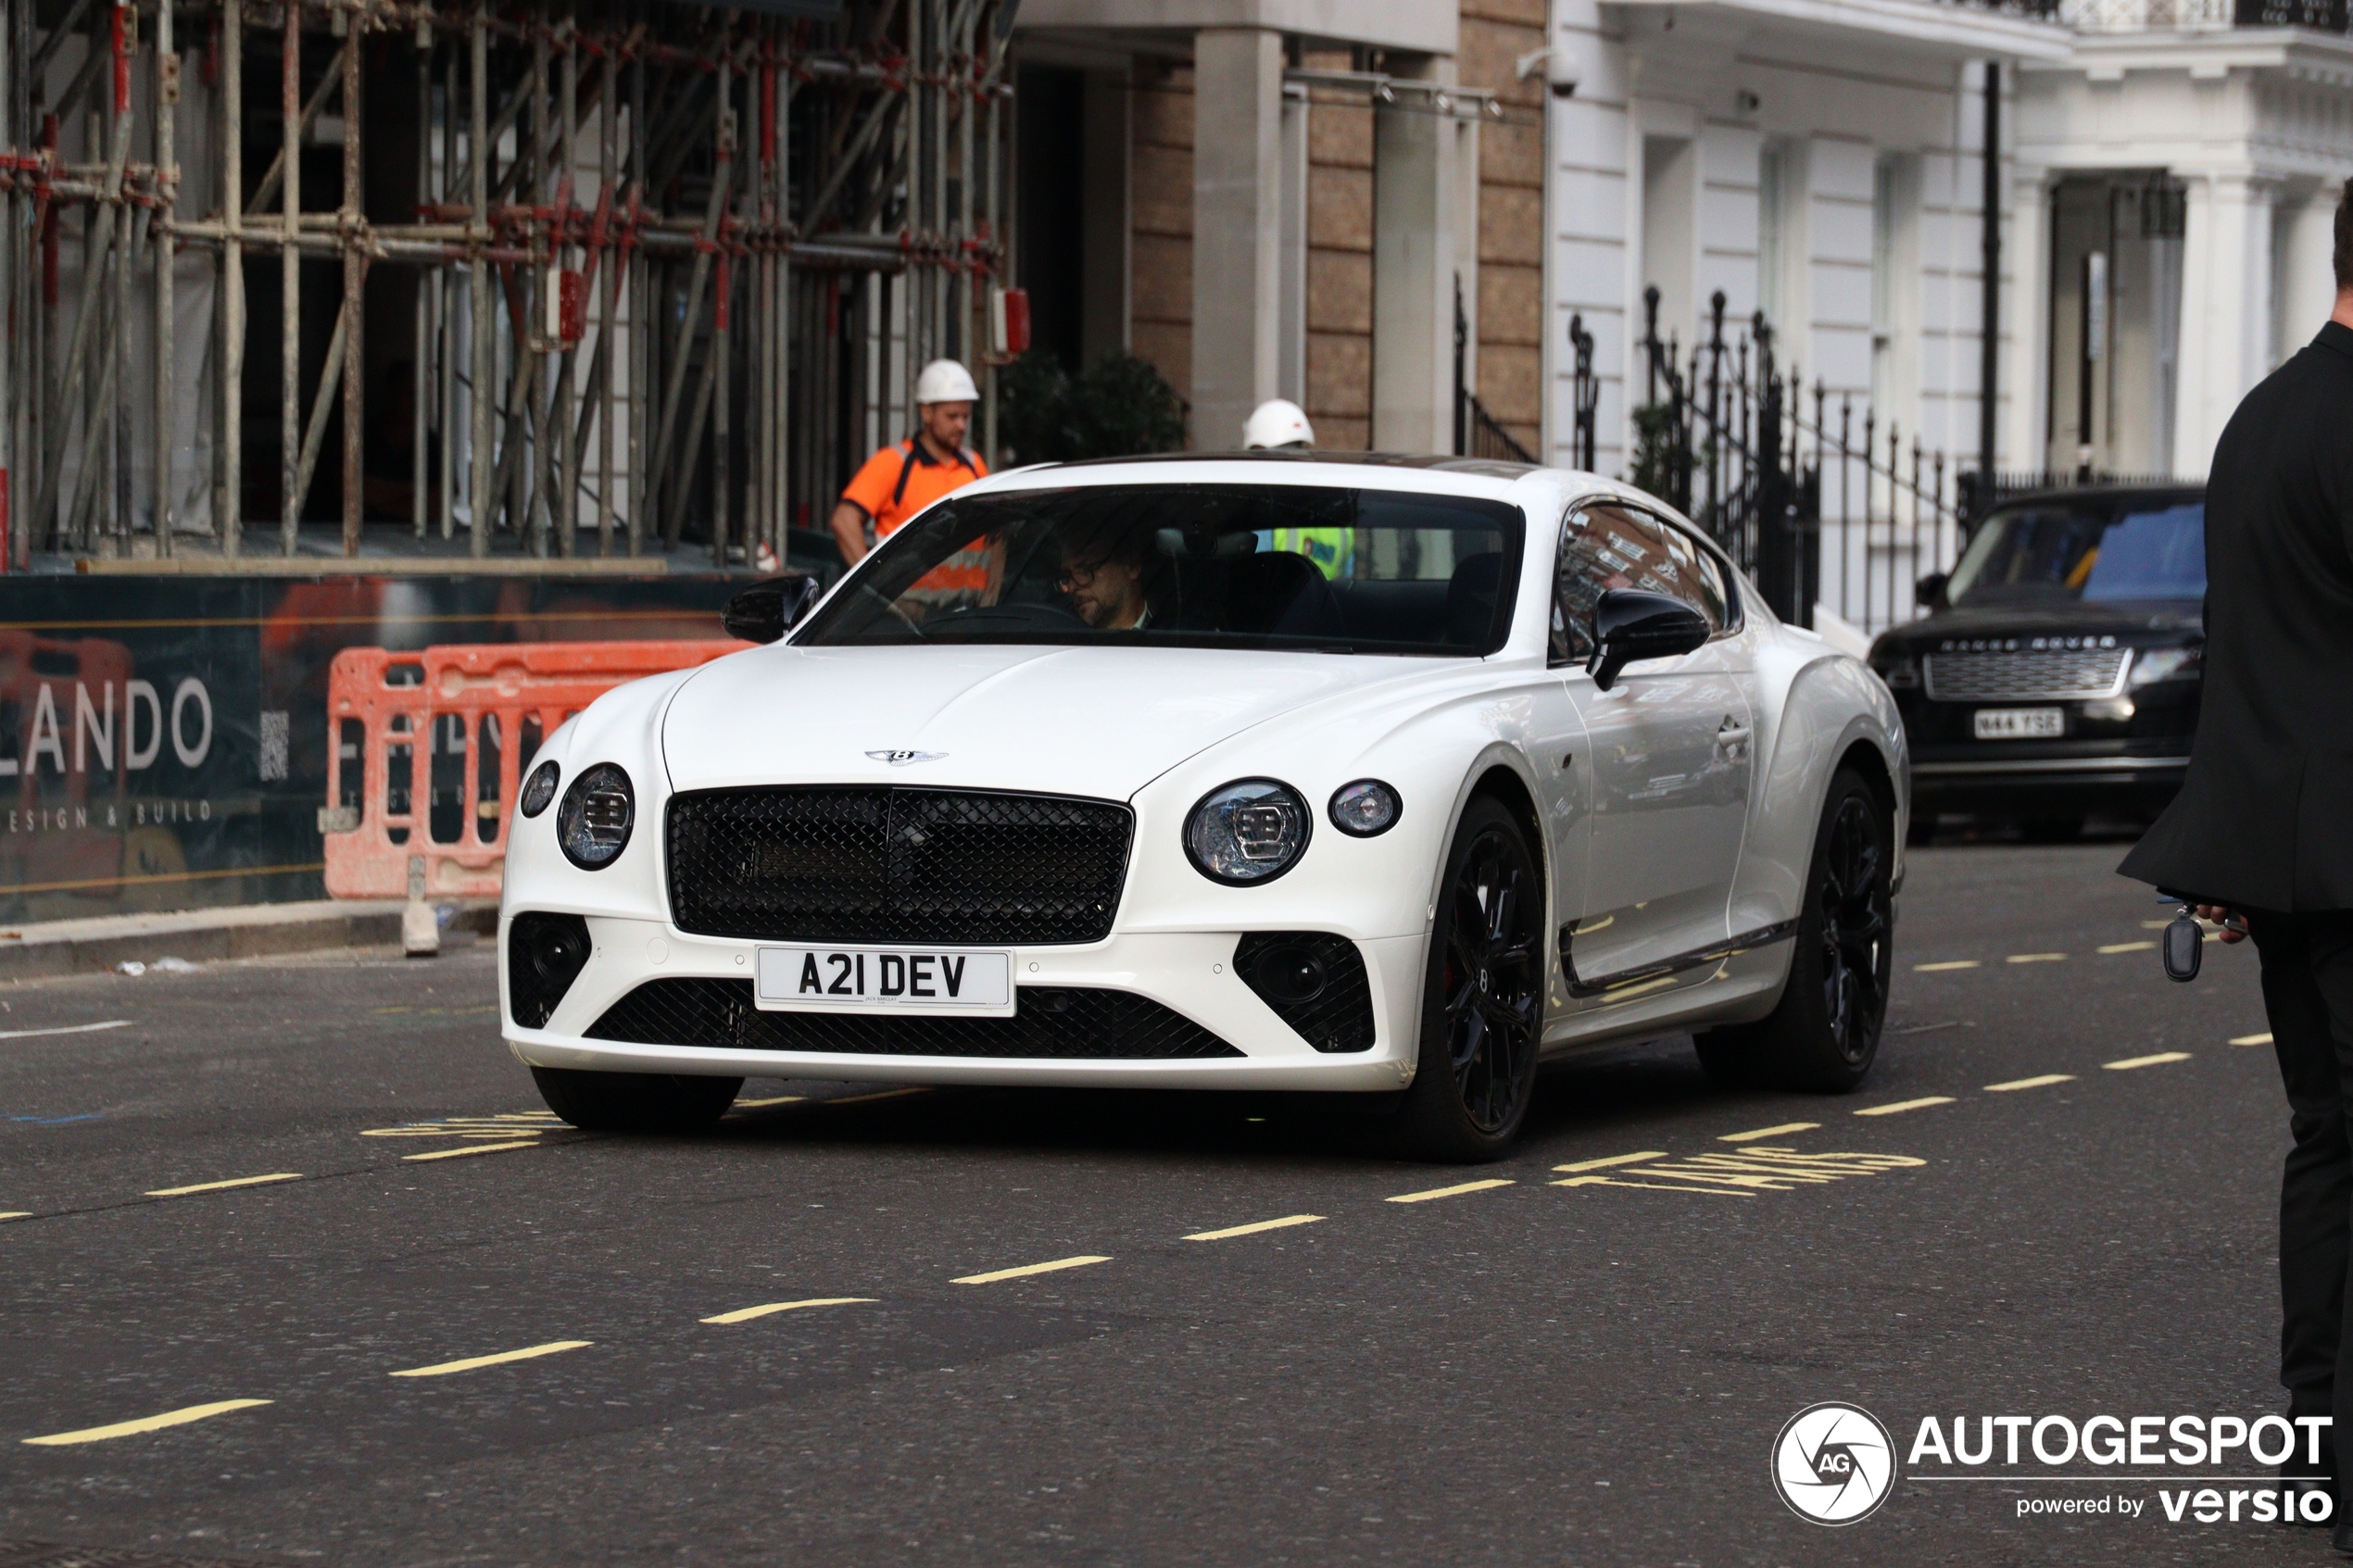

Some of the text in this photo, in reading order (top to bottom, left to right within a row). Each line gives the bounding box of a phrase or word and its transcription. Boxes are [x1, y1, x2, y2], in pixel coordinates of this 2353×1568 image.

[0, 798, 211, 834] ESIGN & BUILD
[799, 952, 966, 997] A21 DEV
[1545, 1147, 1927, 1196] TAXIS
